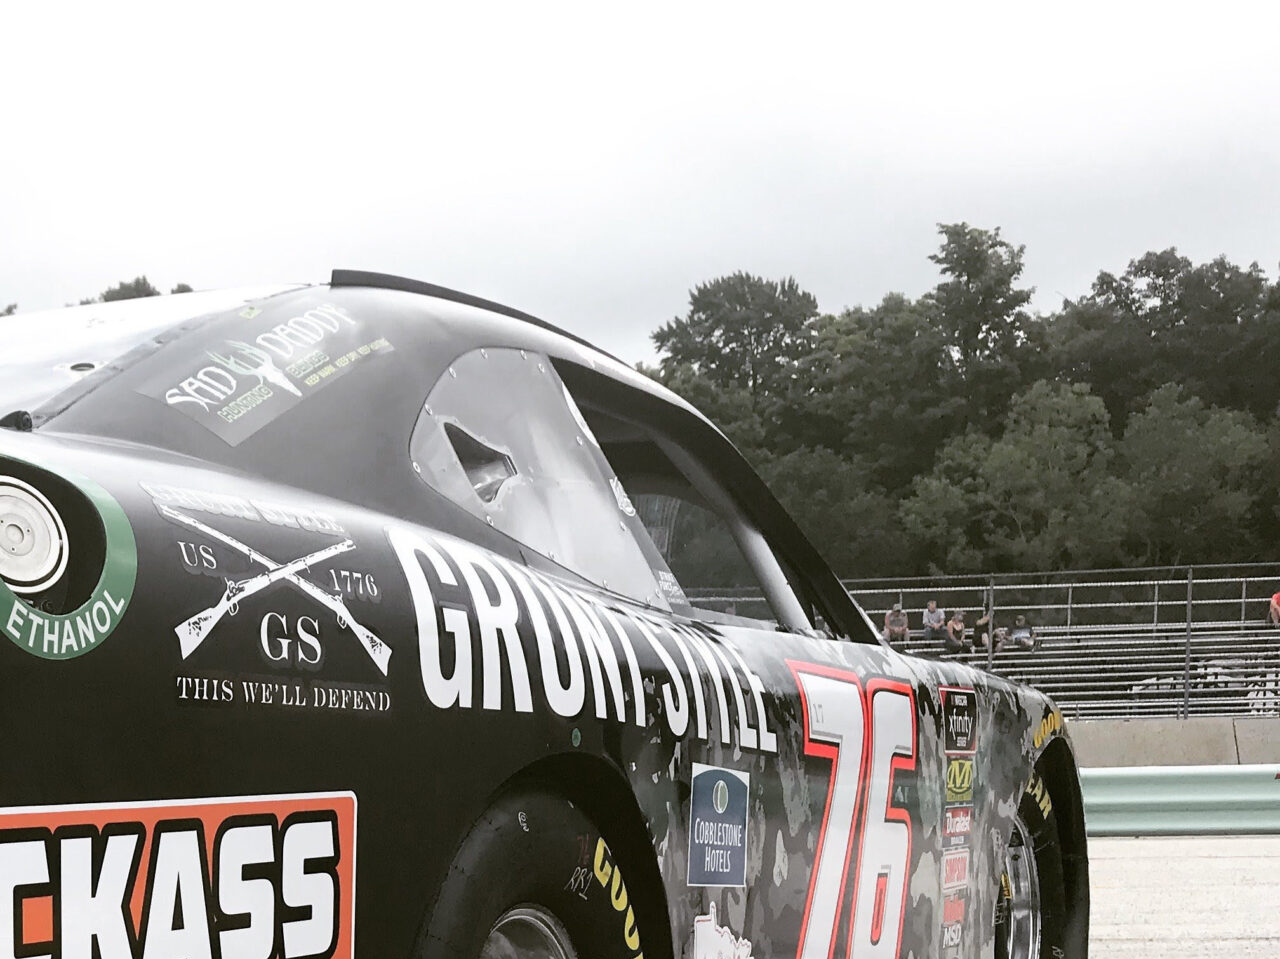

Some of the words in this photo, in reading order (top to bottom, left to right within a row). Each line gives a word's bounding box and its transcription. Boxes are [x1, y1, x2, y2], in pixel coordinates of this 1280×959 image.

[165, 365, 237, 412] SAD
[256, 303, 356, 358] DADDY
[217, 384, 273, 423] HUNTING
[177, 541, 217, 570] US
[329, 568, 378, 597] 1776
[6, 590, 125, 654] ETHANOL
[260, 612, 321, 664] GS
[386, 526, 658, 728] GRUNT
[176, 677, 233, 702] THIS
[242, 681, 306, 706] WE'LL
[313, 687, 391, 711] DEFEND
[949, 708, 973, 741] xfinity
[694, 818, 742, 847] COBBLESTONE
[705, 846, 731, 872] HOTELS
[943, 923, 962, 948] MSD
